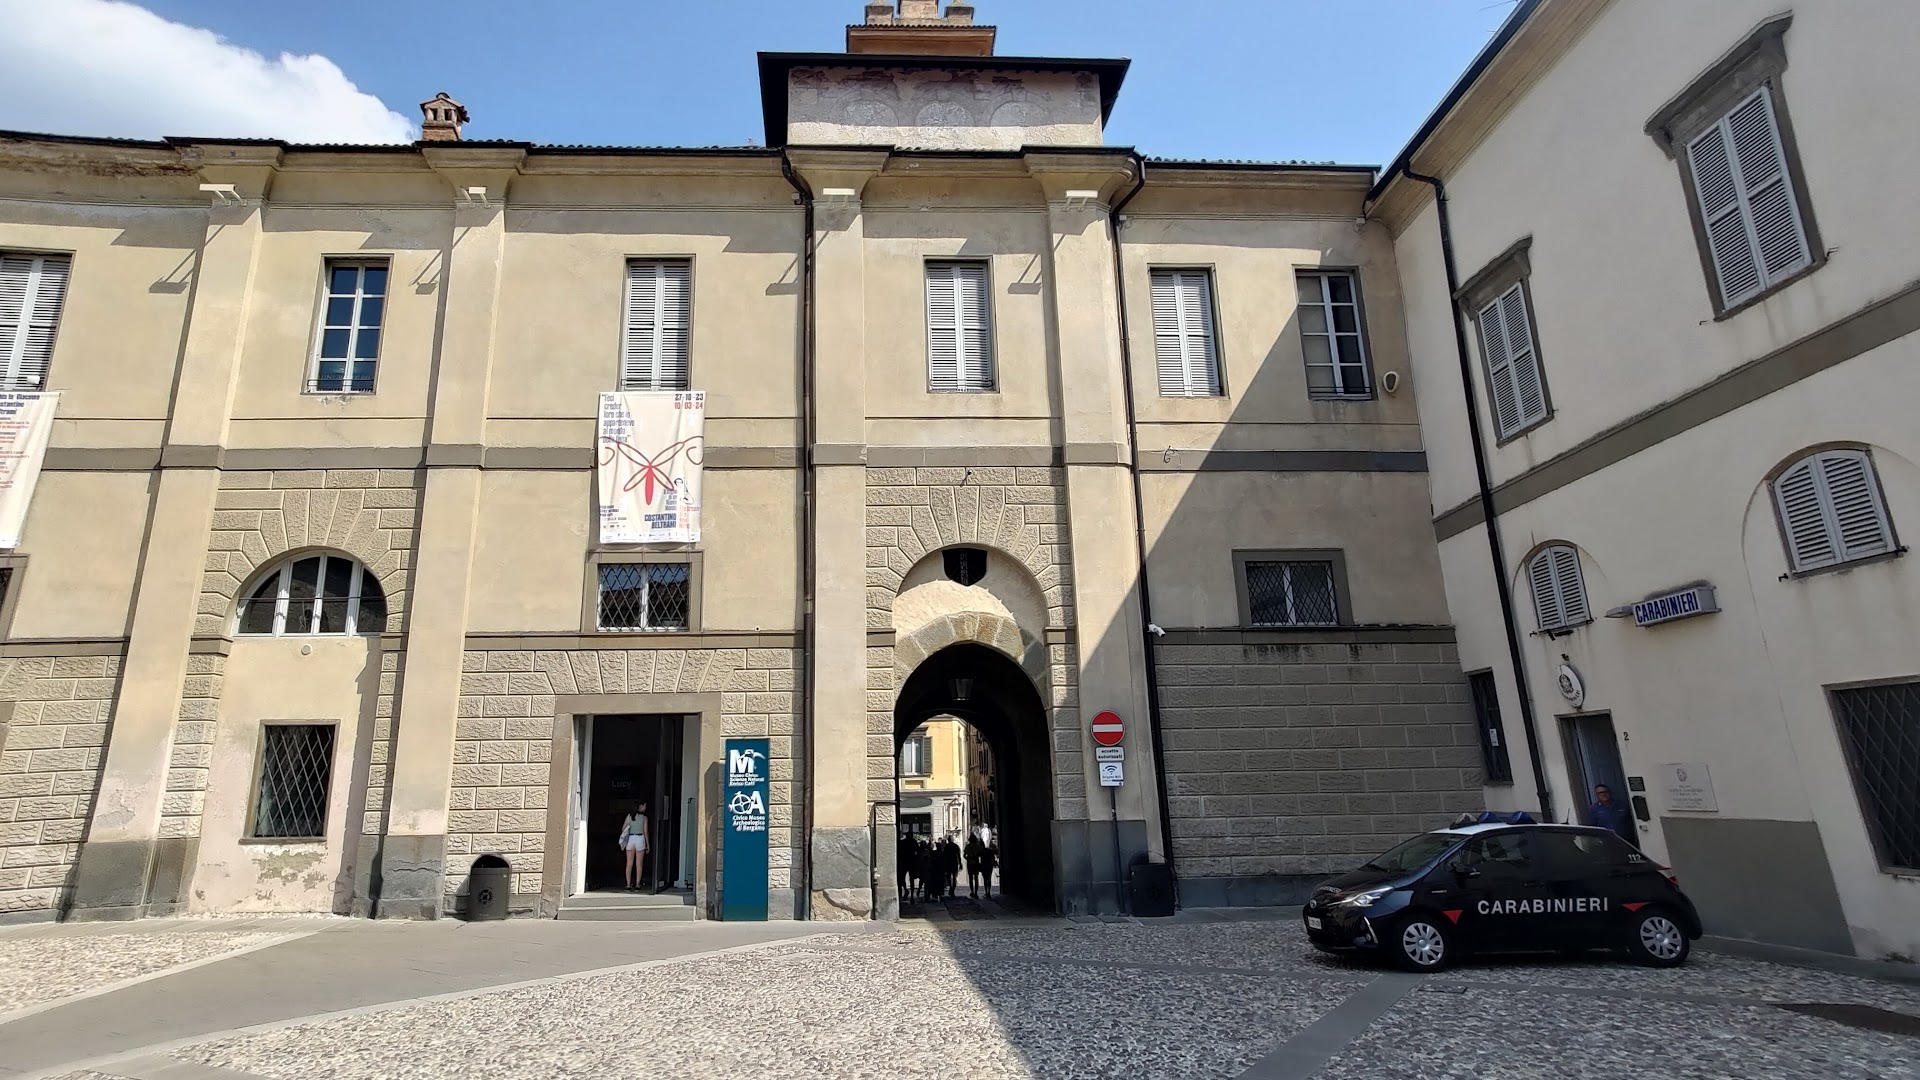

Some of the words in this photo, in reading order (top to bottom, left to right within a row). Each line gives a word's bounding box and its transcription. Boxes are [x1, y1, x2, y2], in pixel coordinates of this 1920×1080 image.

[1635, 591, 1699, 624] CARABINIERI
[1623, 731, 1630, 741] 2
[611, 780, 632, 790] Lucy
[1477, 897, 1609, 915] CARABINIERI
